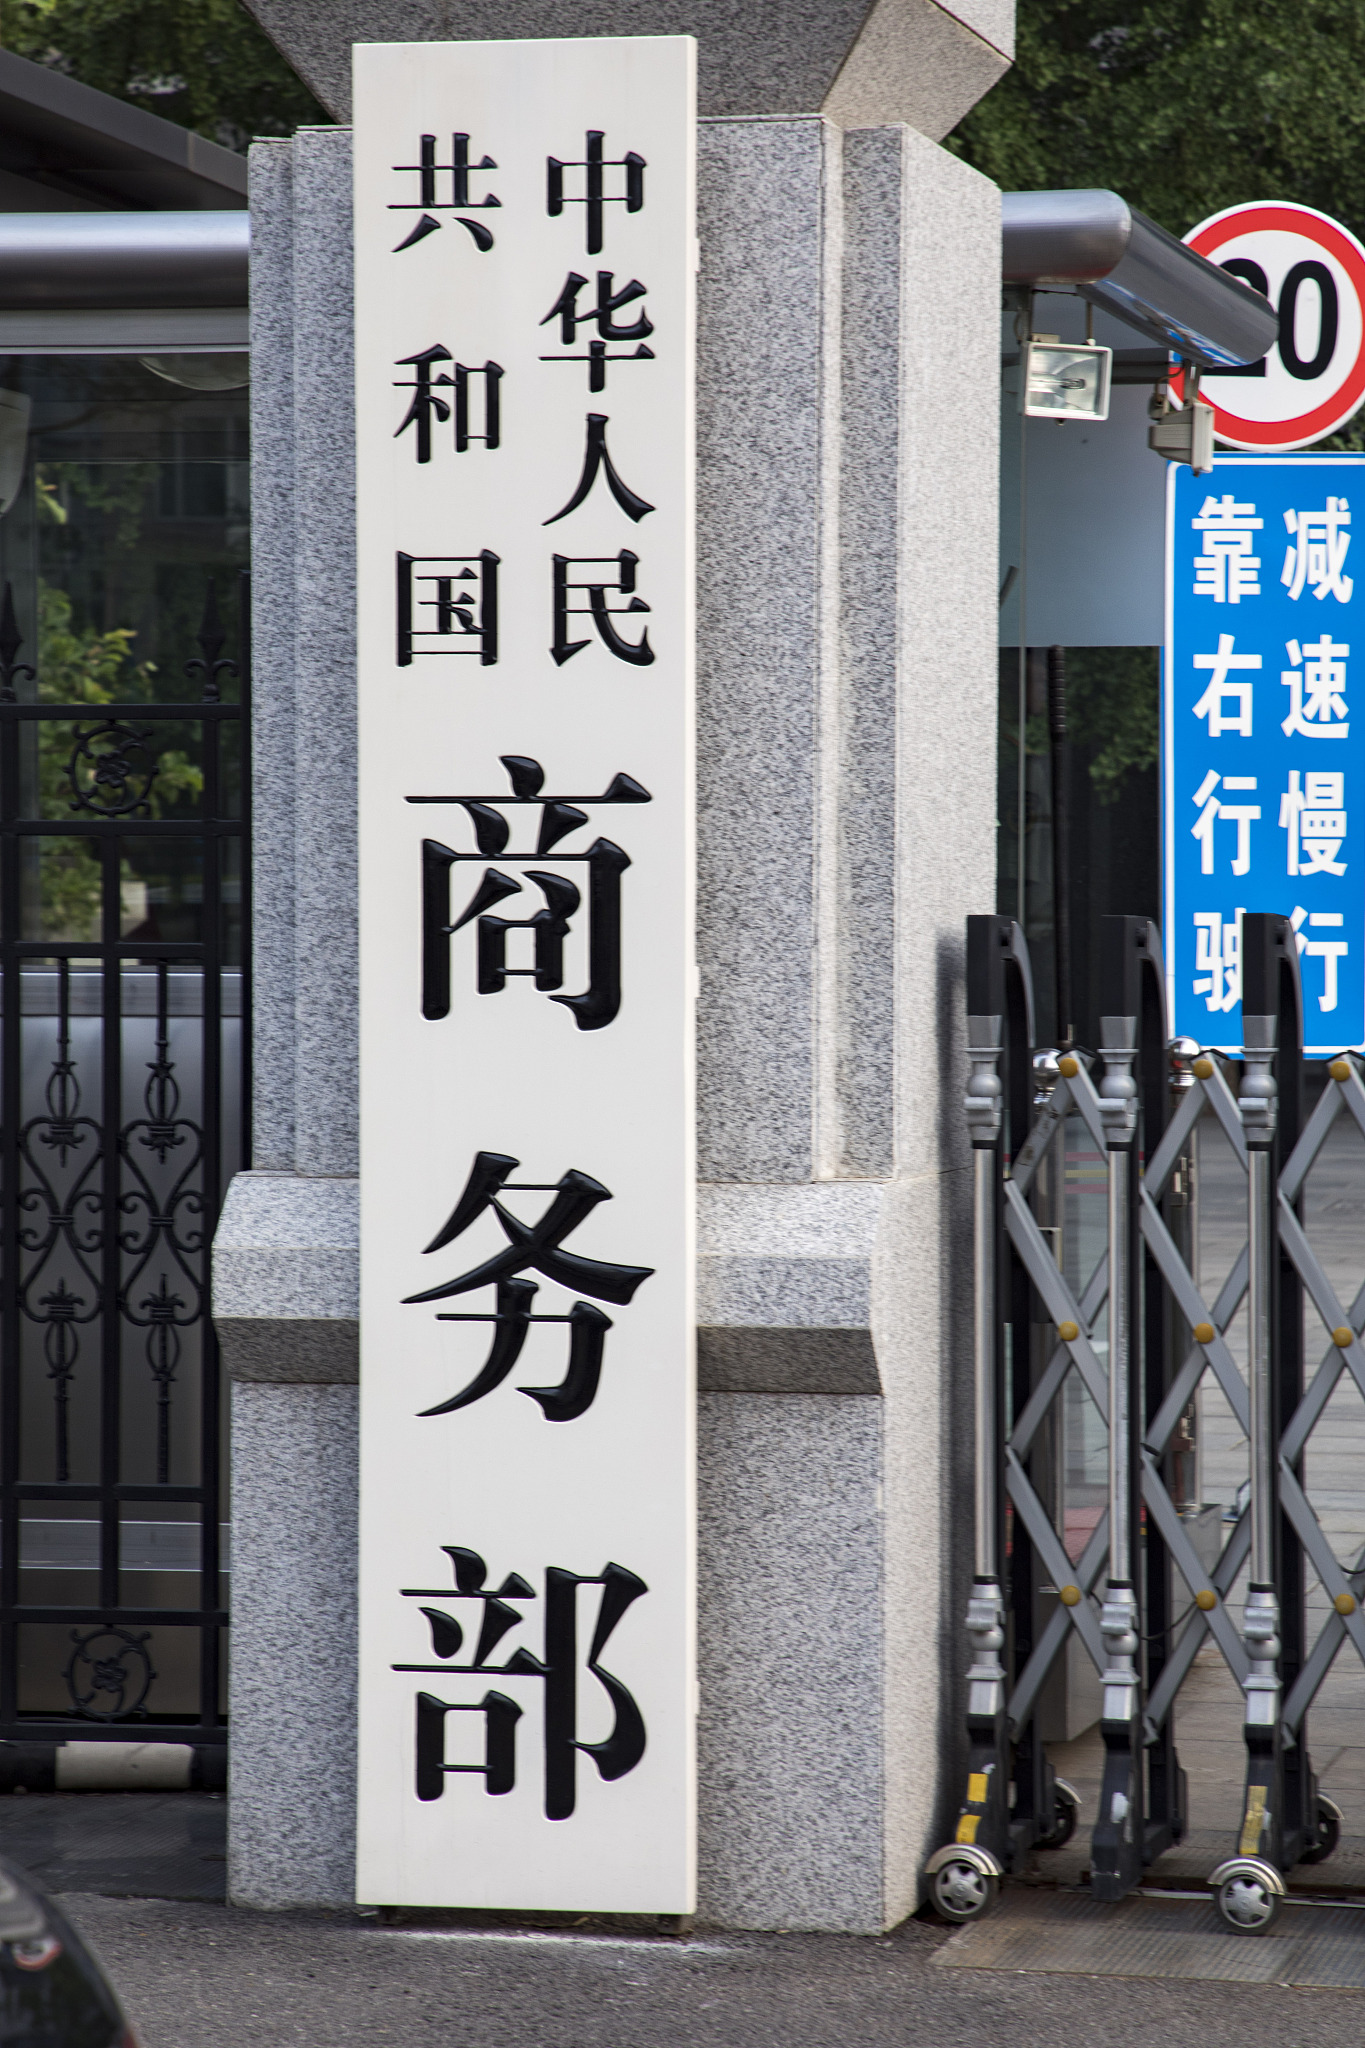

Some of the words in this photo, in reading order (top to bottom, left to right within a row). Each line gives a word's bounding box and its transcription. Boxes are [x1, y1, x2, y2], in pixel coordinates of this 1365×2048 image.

[387, 133, 504, 667] 共和国
[539, 130, 655, 666] 中华人民
[1278, 496, 1354, 1013] 减速慢行
[392, 756, 655, 1820] 商务部
